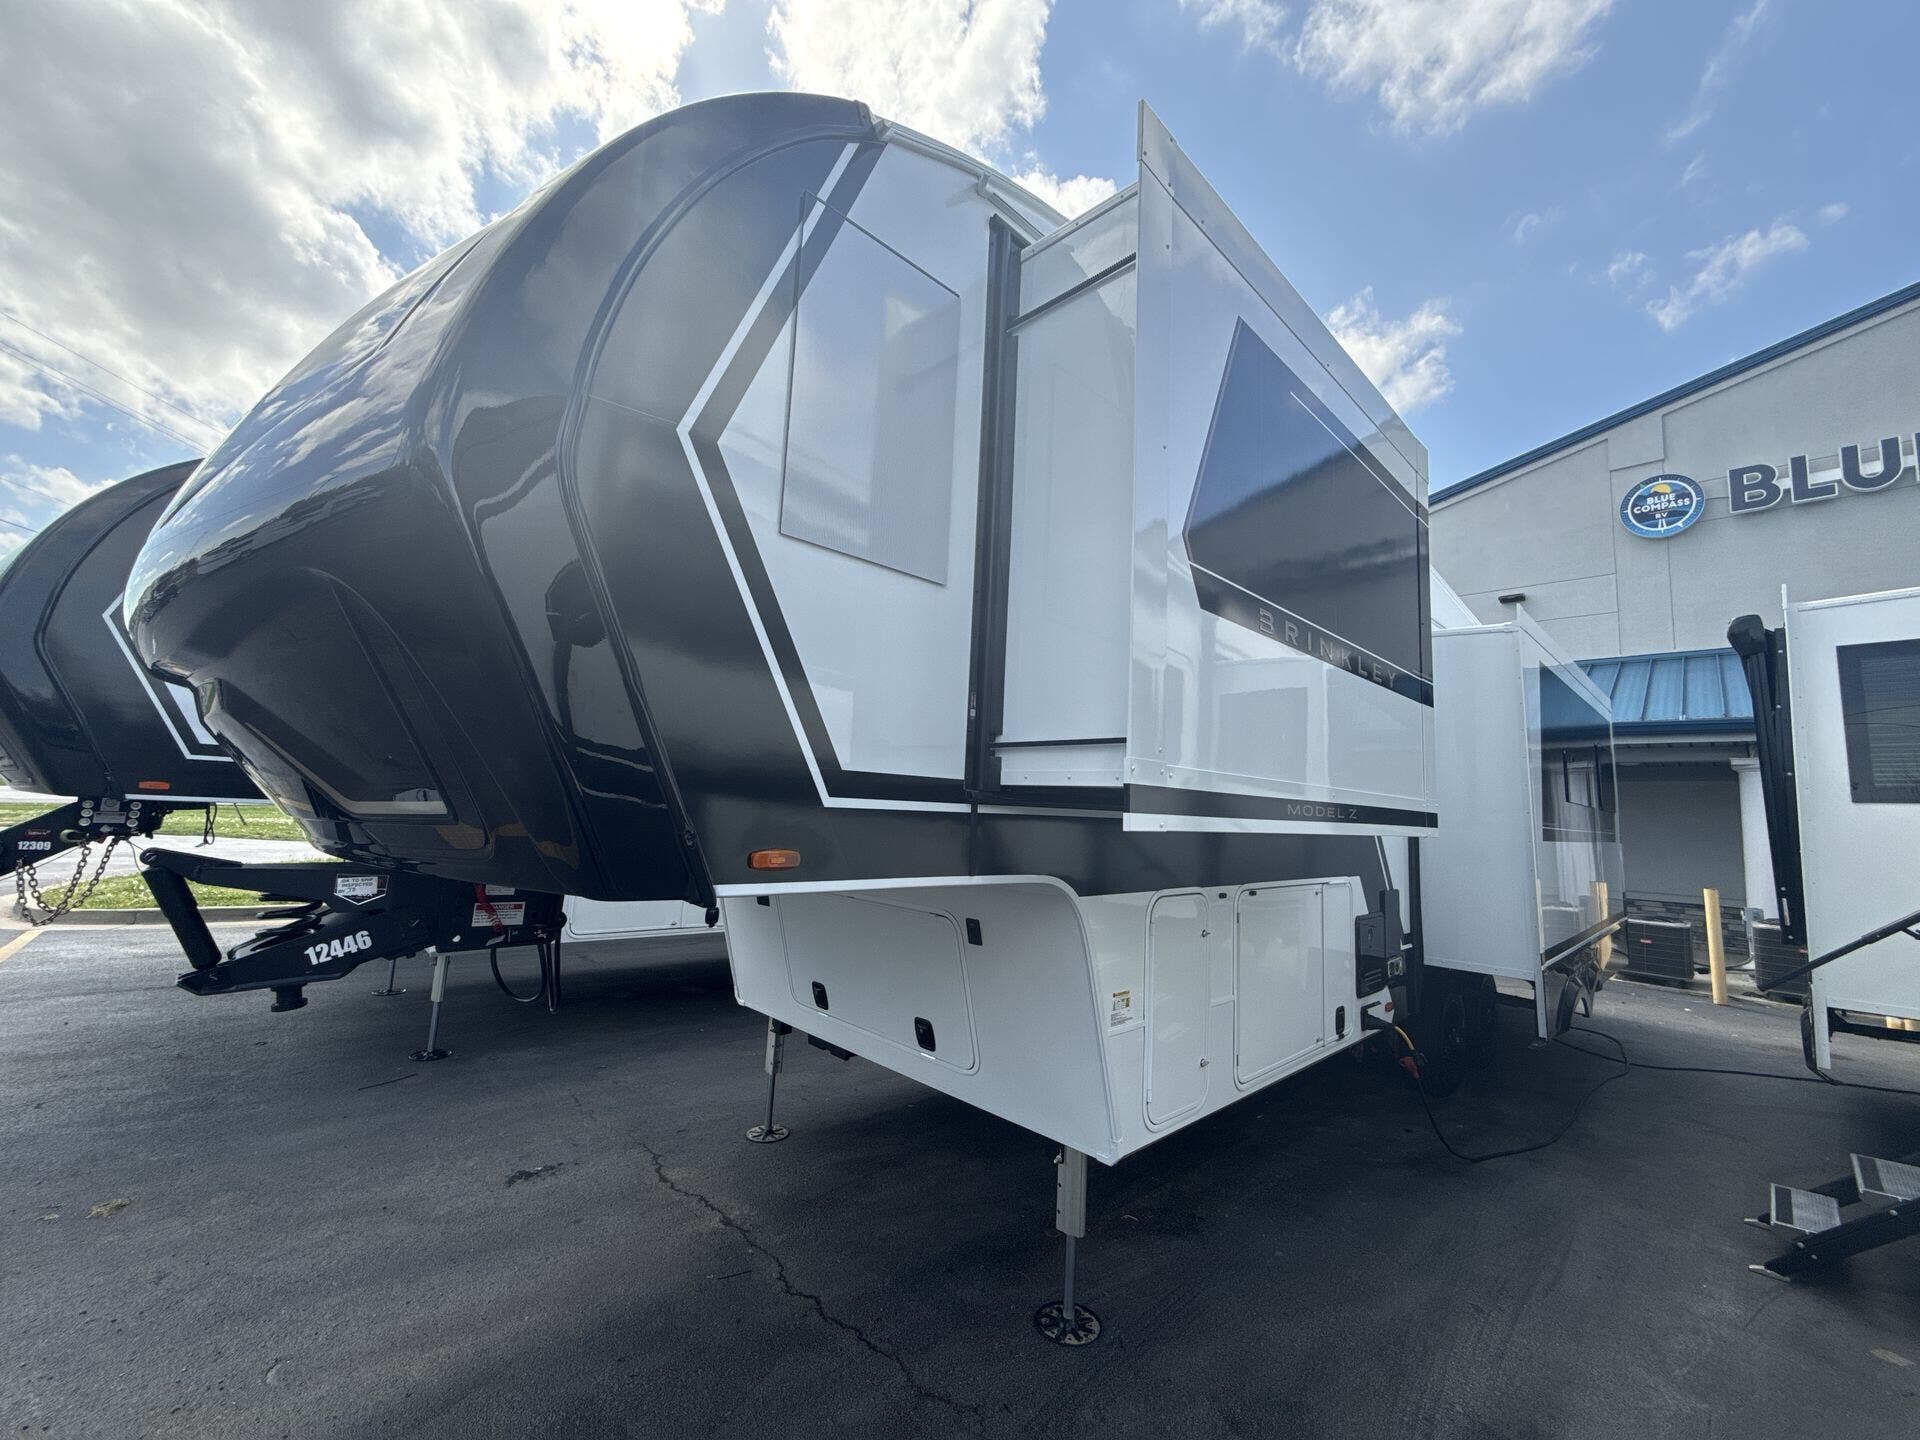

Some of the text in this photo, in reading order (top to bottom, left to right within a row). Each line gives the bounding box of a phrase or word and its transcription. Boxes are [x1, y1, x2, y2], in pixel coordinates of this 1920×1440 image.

[1727, 432, 1920, 514] BLU
[1633, 498, 1691, 514] COMPASS
[1646, 493, 1676, 505] BLUE
[1258, 607, 1397, 688] BRINKLEY
[1287, 803, 1358, 819] MODEL Z
[17, 841, 51, 851] 12309
[304, 930, 372, 965] 12446
